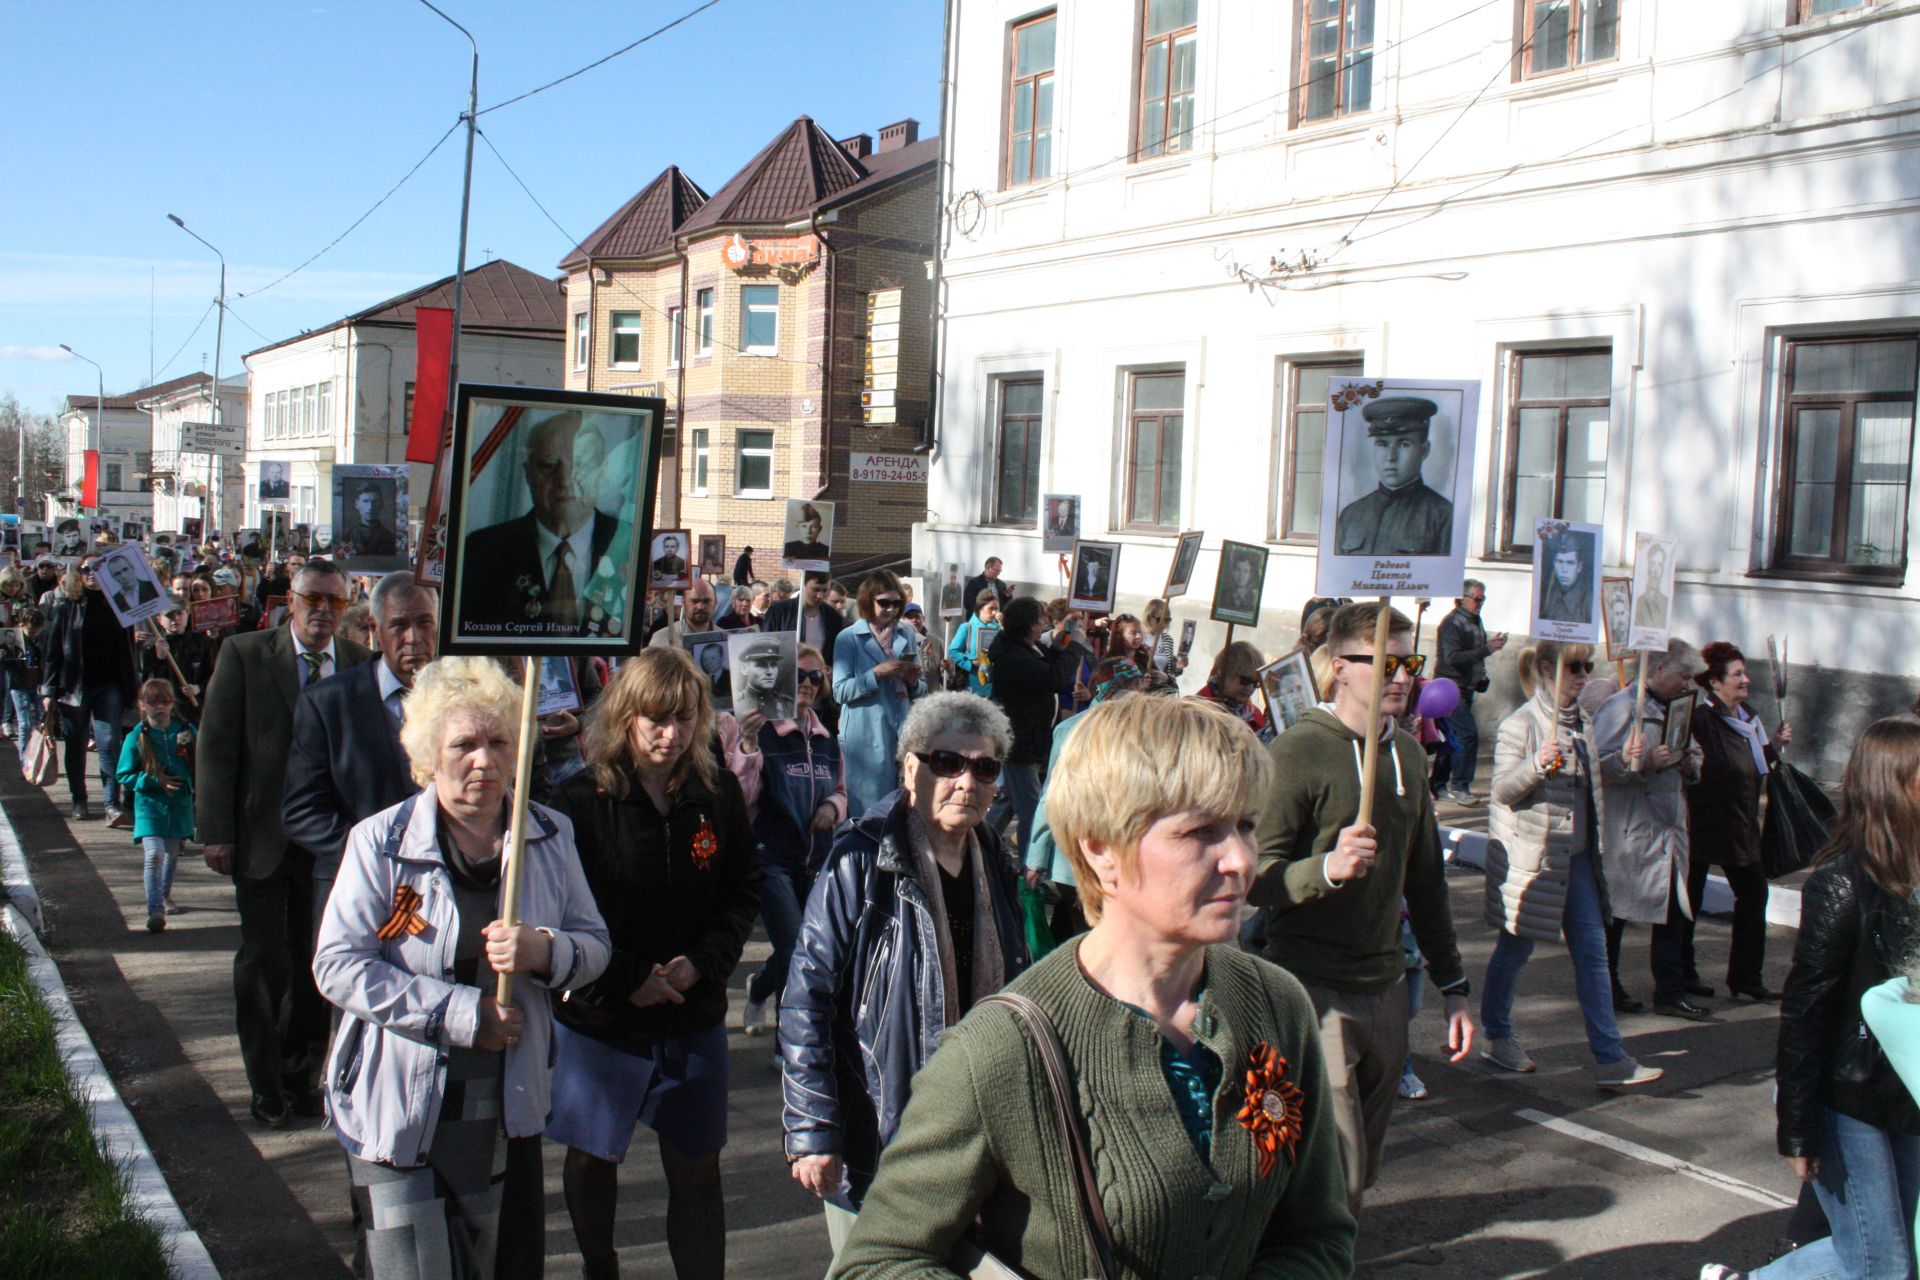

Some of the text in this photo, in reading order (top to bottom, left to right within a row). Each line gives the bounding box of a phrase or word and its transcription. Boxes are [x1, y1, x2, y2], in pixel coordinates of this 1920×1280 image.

[195, 424, 236, 433] БУТЛЕРОВА
[195, 439, 231, 447] ТОЛСТОГО
[866, 456, 920, 469] АРЕНДА
[1374, 559, 1411, 569] Рядовой
[1371, 569, 1413, 581] Цветов
[1350, 580, 1430, 590] Михаил Ильич
[463, 620, 581, 634] Козлов Сергей Ильич
